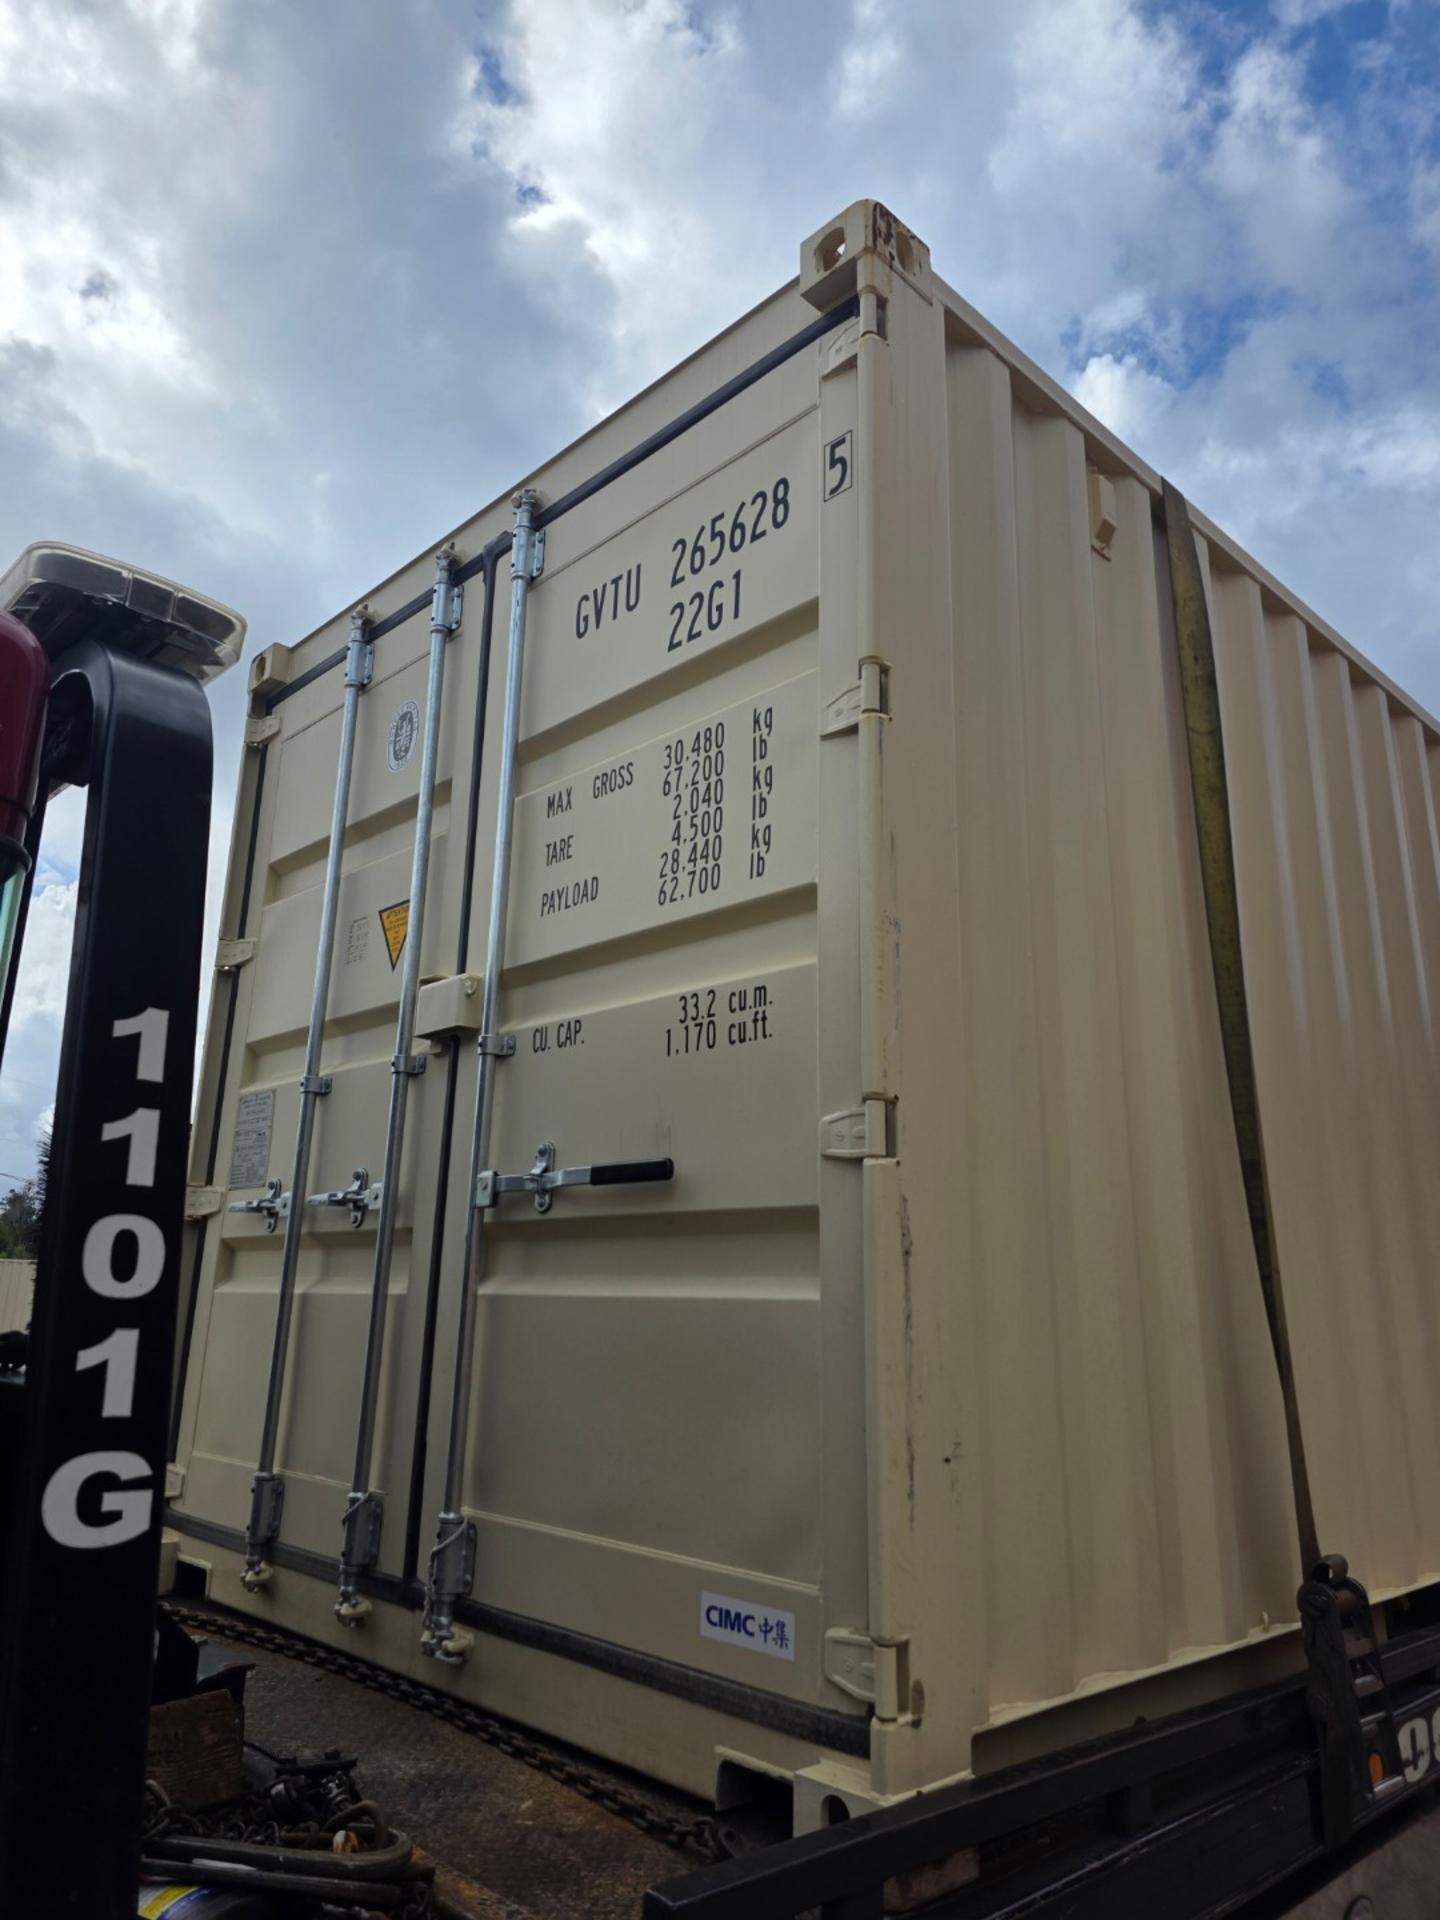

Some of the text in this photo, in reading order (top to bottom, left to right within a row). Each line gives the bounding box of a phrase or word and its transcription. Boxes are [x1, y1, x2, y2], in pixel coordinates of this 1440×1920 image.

[575, 437, 848, 639] GVTU 265628 5
[667, 569, 742, 653] 22G1
[547, 786, 573, 819] MAX
[592, 762, 634, 799] GROSS
[753, 706, 773, 737] kg
[753, 734, 768, 762] lb
[545, 835, 574, 867] TARE
[752, 765, 773, 795] kg
[752, 793, 768, 820] lb
[540, 876, 599, 917] PAYLOAD
[751, 823, 772, 853] kg
[750, 852, 765, 880] lb
[533, 984, 774, 1053] CU. CAP. 33.2 cu.m.
[728, 1010, 773, 1045] cu.ft.
[41, 1006, 170, 1550] 1101G
[705, 1605, 756, 1638] CIMC
